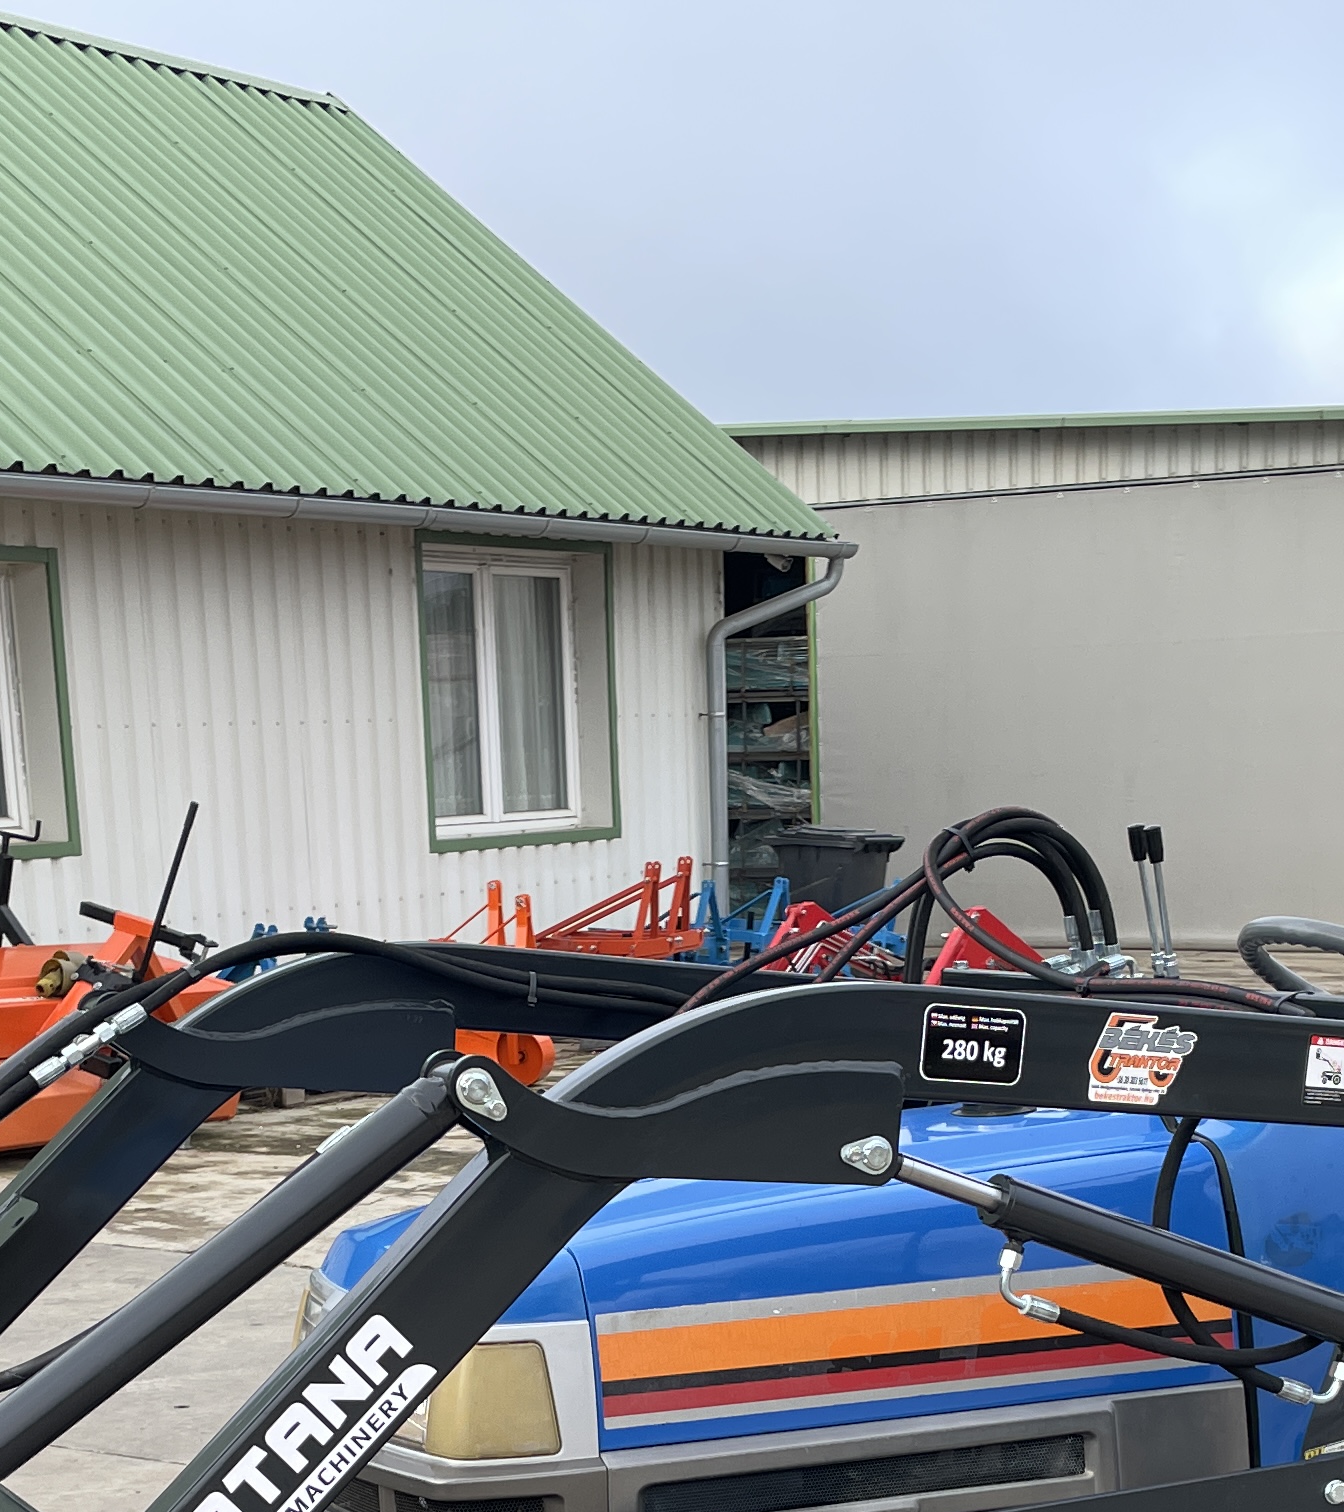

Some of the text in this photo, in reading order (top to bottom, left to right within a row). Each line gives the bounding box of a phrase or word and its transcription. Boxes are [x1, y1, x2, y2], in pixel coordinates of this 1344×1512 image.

[941, 1039, 1007, 1067] 280 kg
[1098, 1025, 1196, 1054] BÉKÉS
[1109, 1053, 1181, 1071] TRAKTOR
